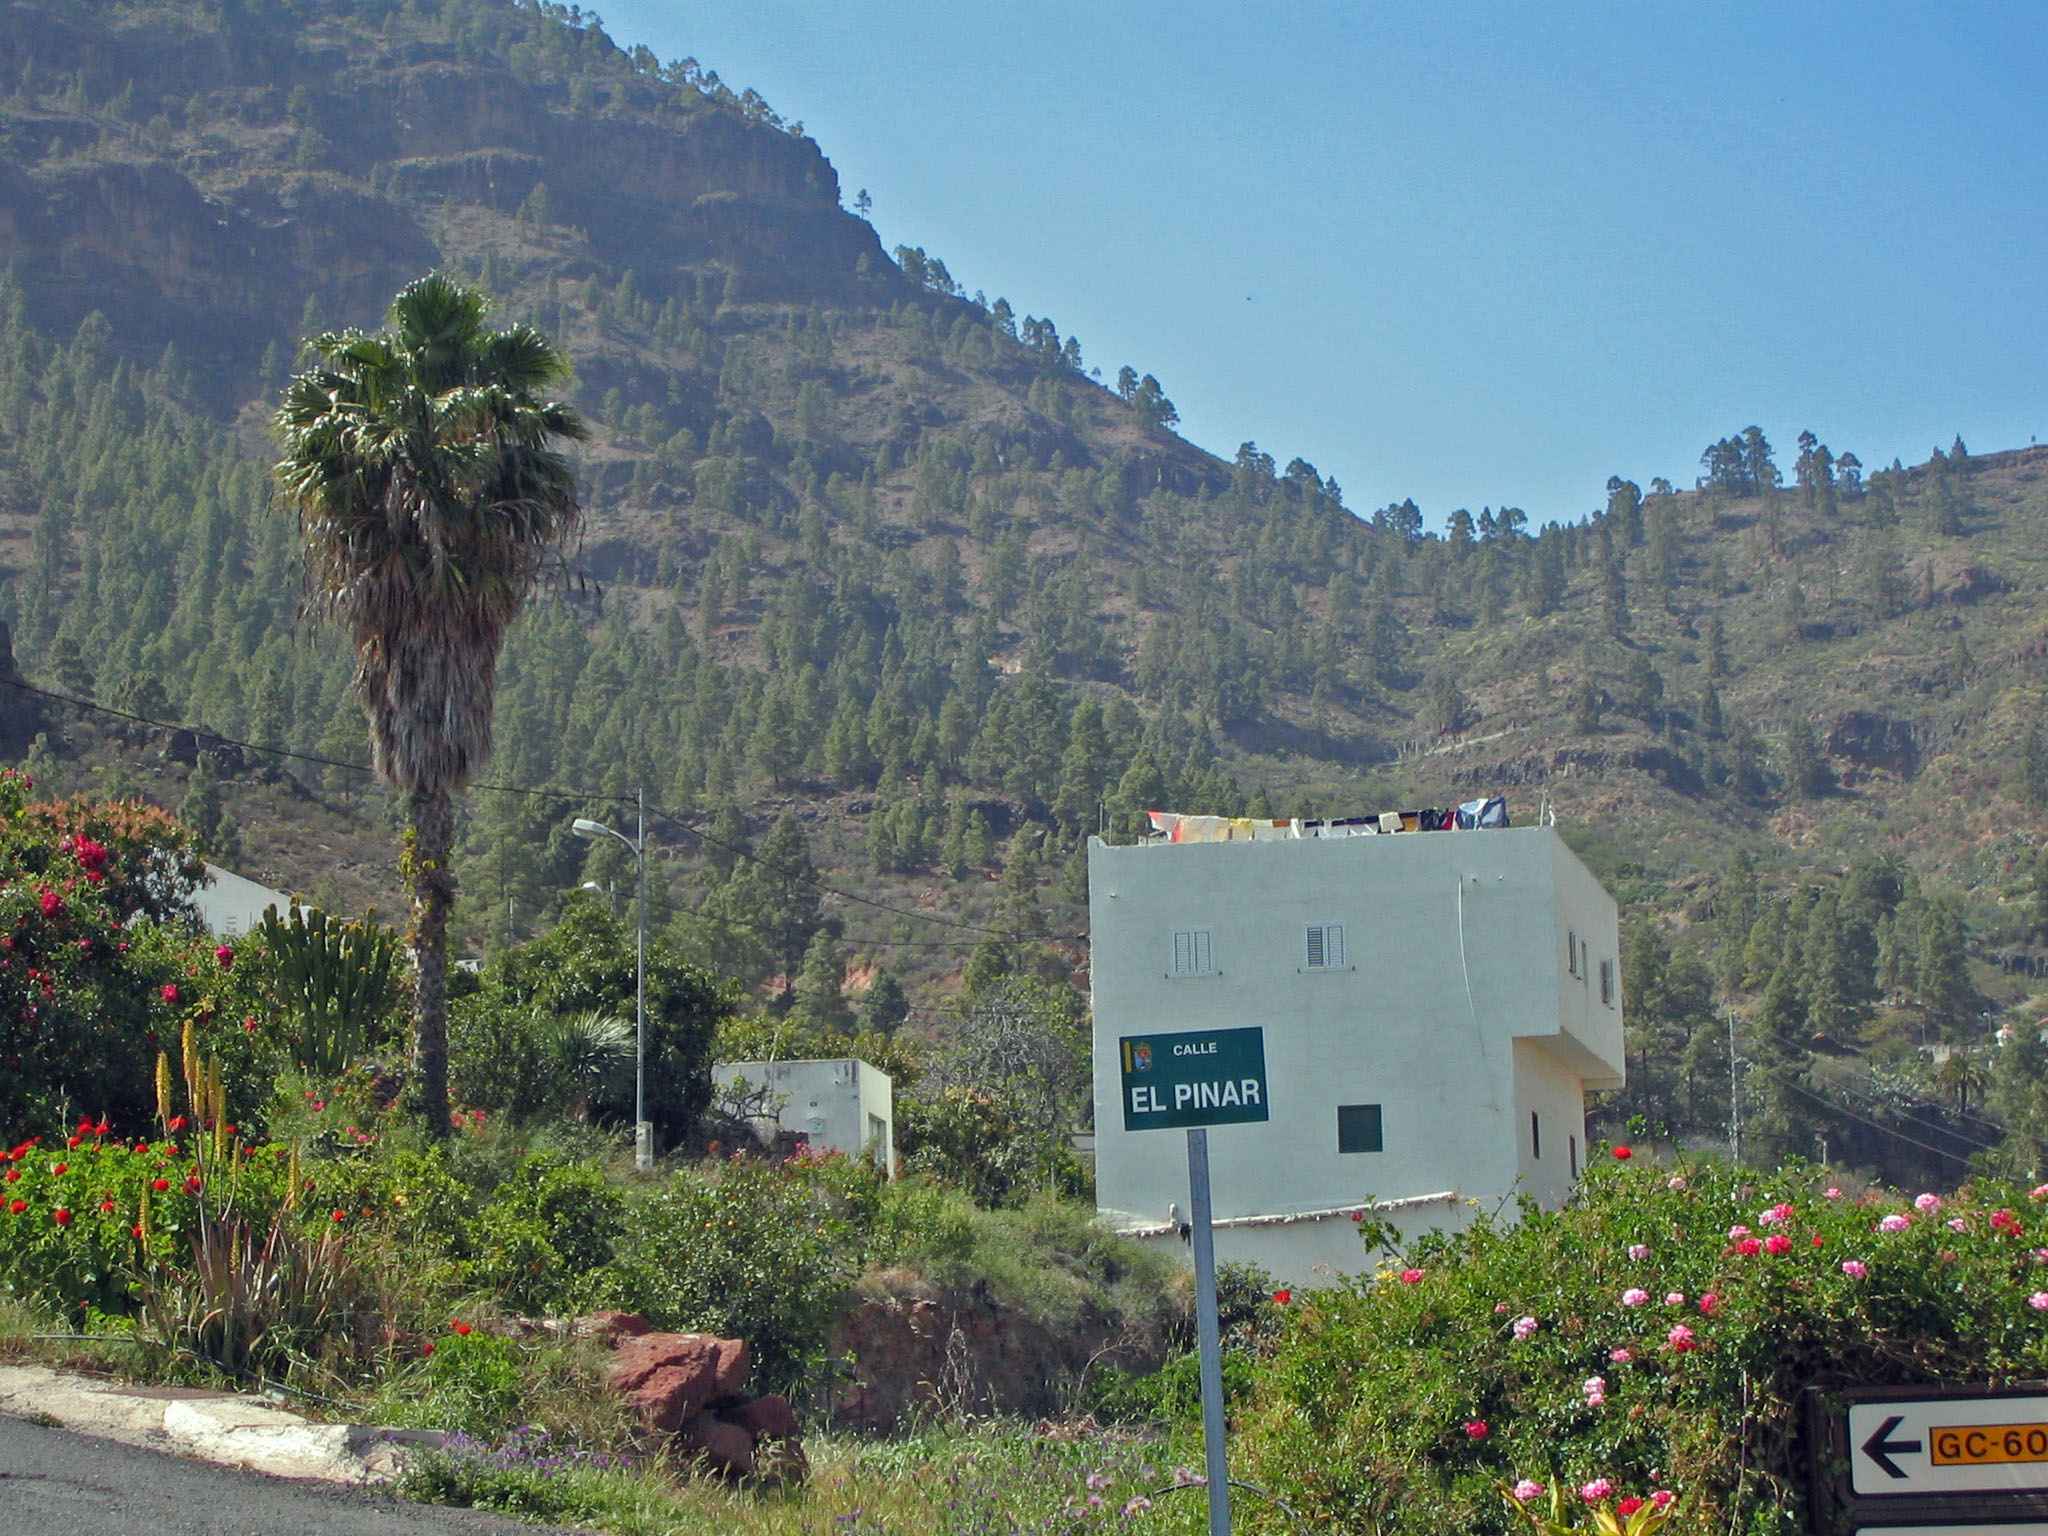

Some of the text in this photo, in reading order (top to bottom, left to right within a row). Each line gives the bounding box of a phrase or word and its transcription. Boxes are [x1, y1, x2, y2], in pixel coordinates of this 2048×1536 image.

[1173, 1042, 1217, 1056] CALLE
[1131, 1079, 1260, 1113] EL PINAR
[1938, 1430, 2047, 1459] GC-60
